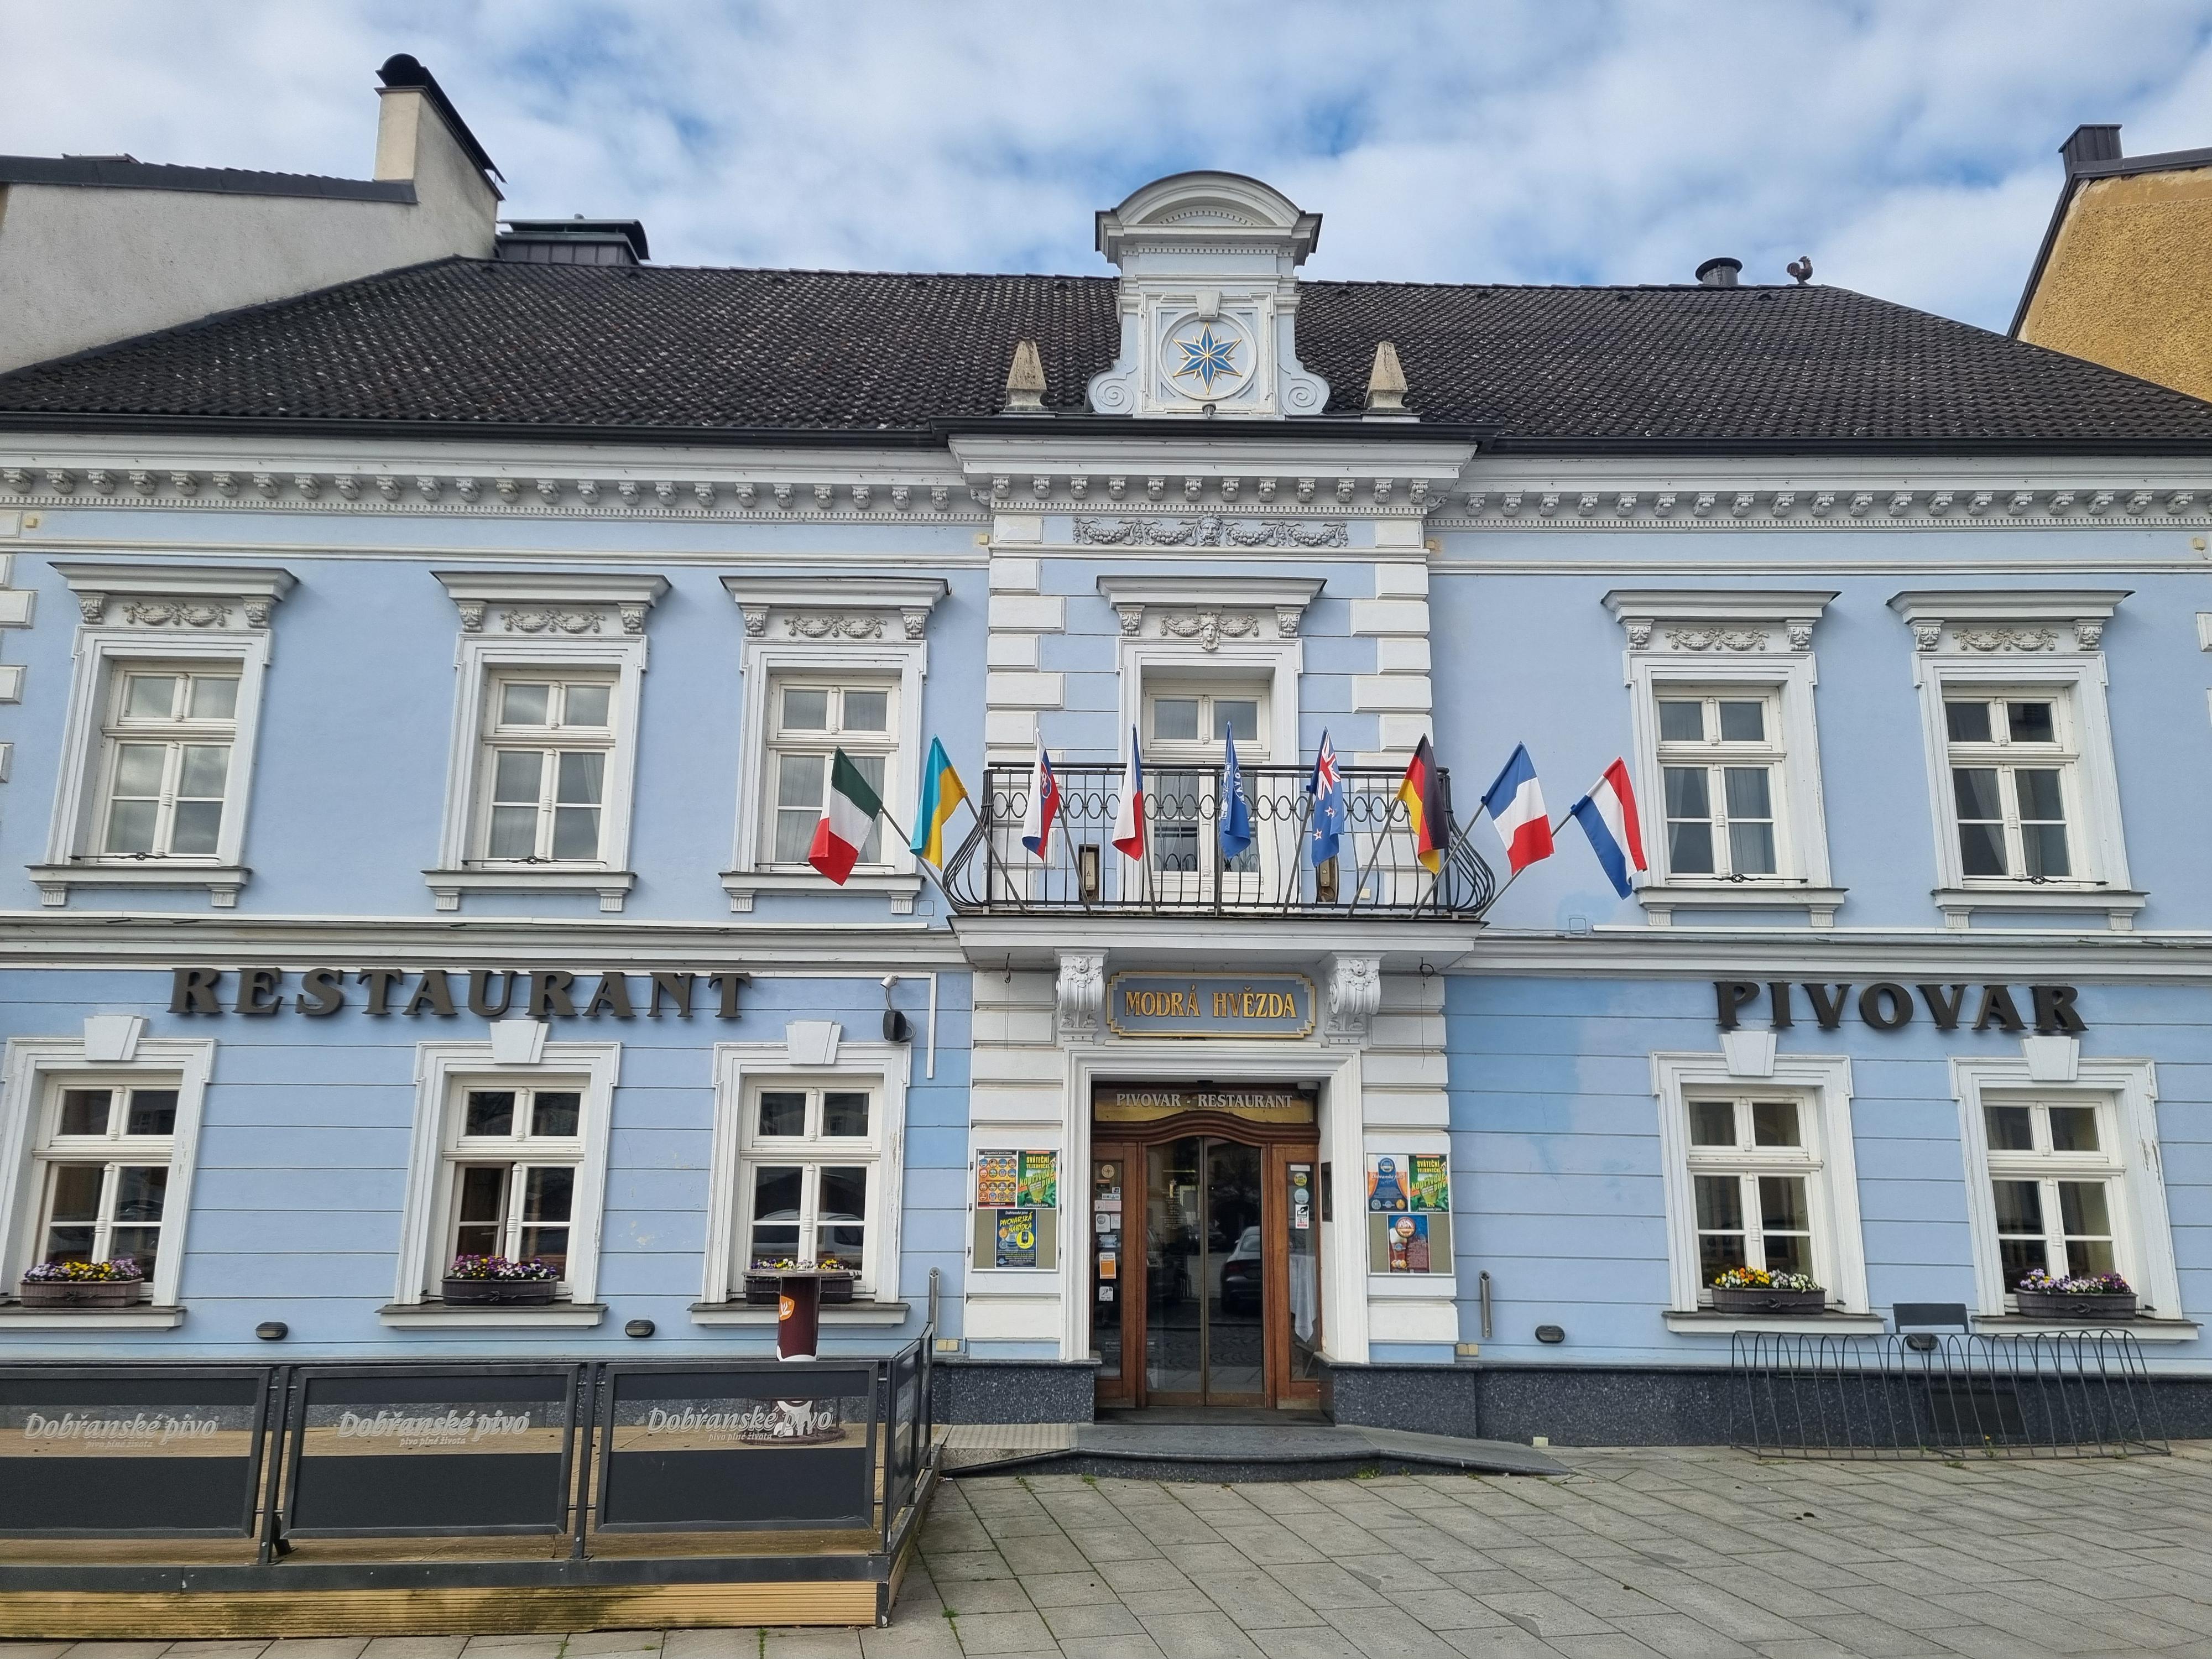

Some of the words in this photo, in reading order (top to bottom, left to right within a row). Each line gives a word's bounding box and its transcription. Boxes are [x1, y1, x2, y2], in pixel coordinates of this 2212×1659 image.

[166, 967, 752, 1020] RESTAURANT
[1125, 984, 1201, 1017] MODRÁ
[1213, 987, 1297, 1018] HVĚZDA
[1713, 981, 2089, 1031] PIVOVAR
[1117, 1093, 1181, 1107] PIVOVAR
[1198, 1094, 1292, 1108] RESTAURANT
[23, 1412, 164, 1439] Dobřanské
[160, 1413, 220, 1445] pivo
[337, 1410, 475, 1437] Dobřanské
[472, 1410, 531, 1442] pivo
[647, 1406, 779, 1433] Dobřanské
[777, 1407, 834, 1437] pivo
[708, 1433, 726, 1442] pivo
[727, 1432, 746, 1442] plné
